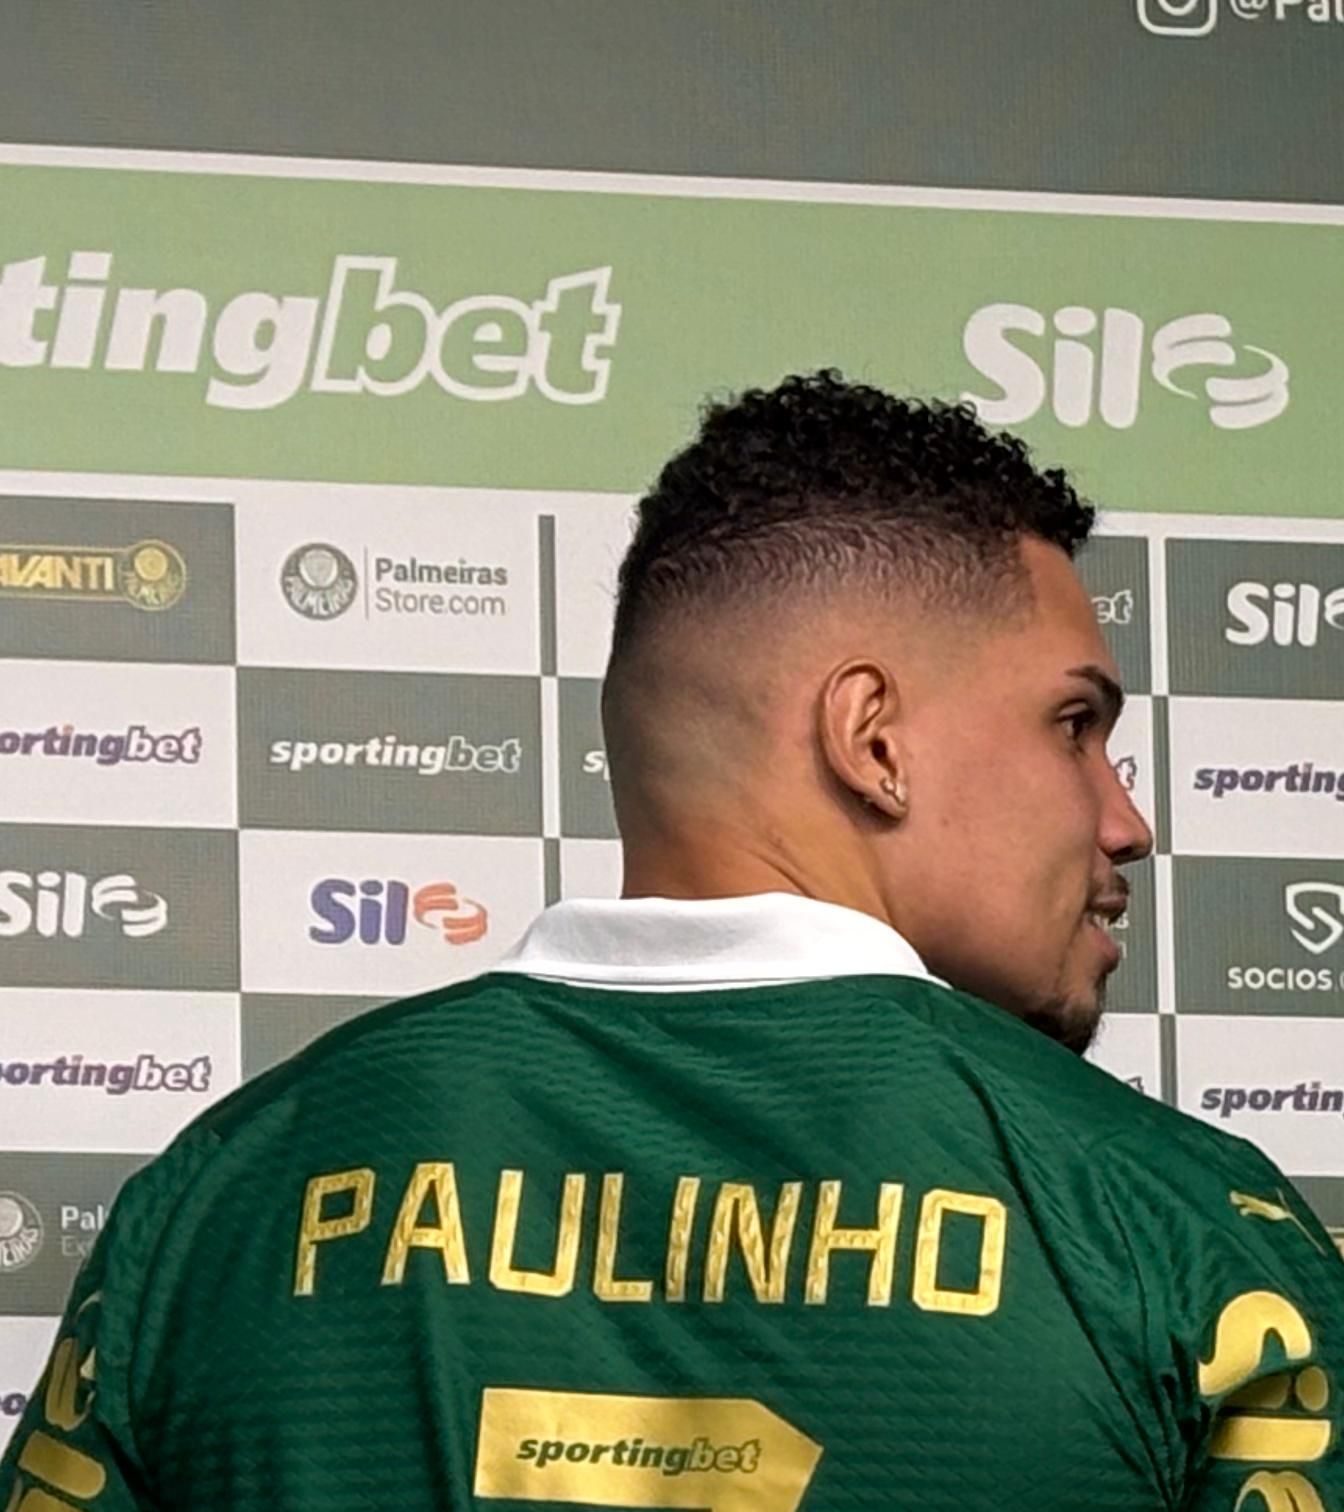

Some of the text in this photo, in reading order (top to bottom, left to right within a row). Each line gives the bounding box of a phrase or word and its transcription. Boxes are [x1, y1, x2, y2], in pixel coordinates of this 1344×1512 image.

[960, 304, 1144, 429] Sil
[376, 558, 507, 588] Palmeiras
[376, 590, 505, 616] Store.com
[1226, 582, 1320, 646] Sil
[271, 736, 521, 775] sportingbet
[310, 879, 409, 945] Sil
[295, 1163, 1007, 1316] PAULINHO
[517, 1434, 762, 1475] sportingbet
